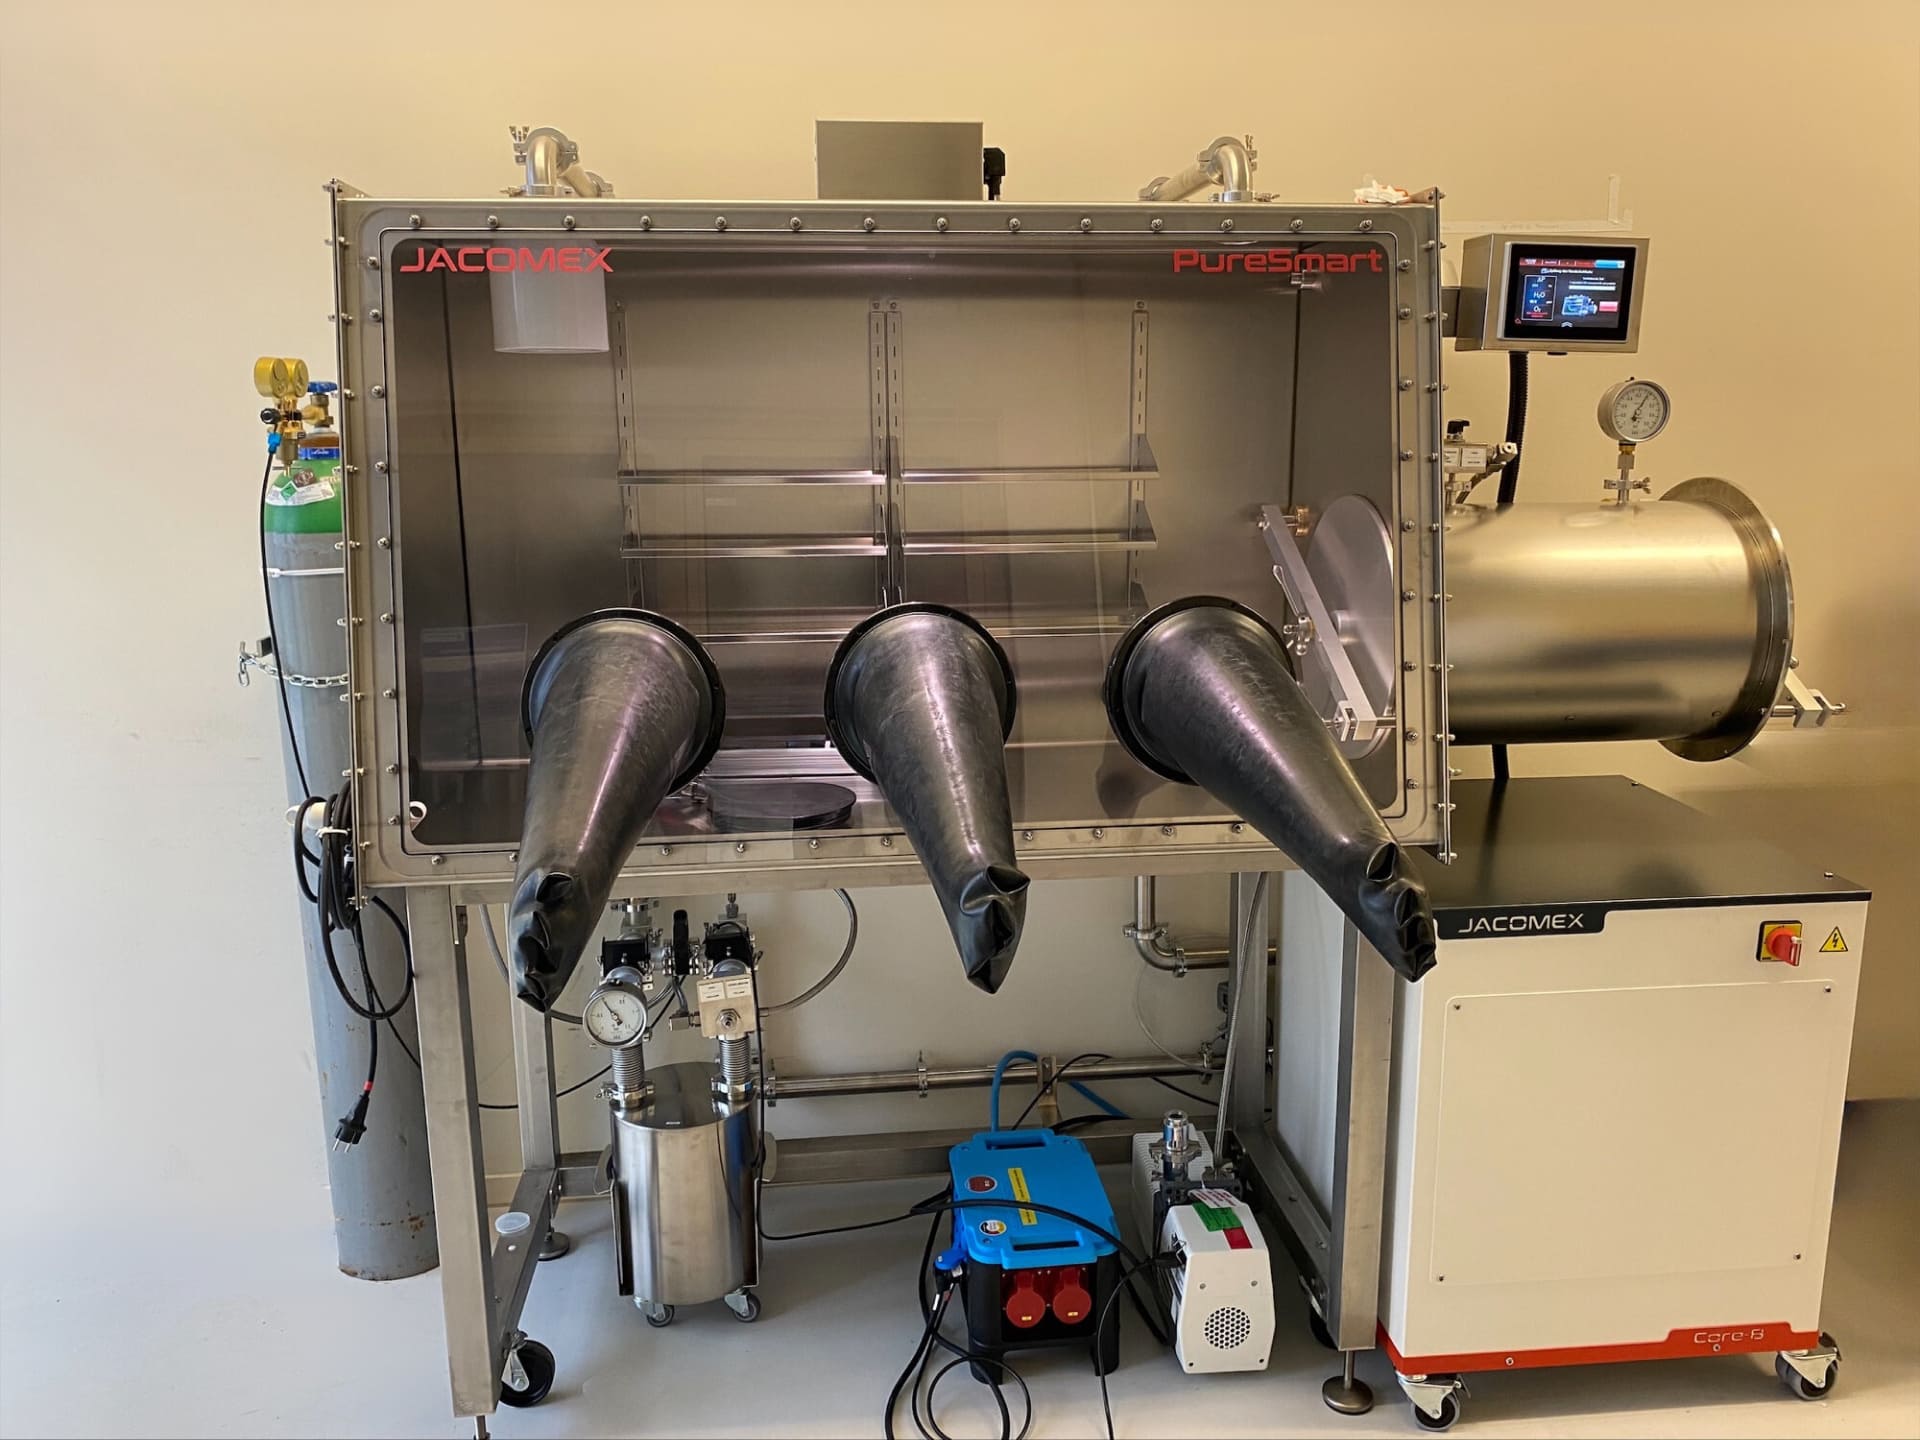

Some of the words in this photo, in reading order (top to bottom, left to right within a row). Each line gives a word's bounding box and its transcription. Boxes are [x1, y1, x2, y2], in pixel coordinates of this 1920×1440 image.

[399, 247, 613, 273] JACOMEX
[1172, 248, 1383, 273] PureSmart
[1457, 913, 1584, 933] JACOMEX
